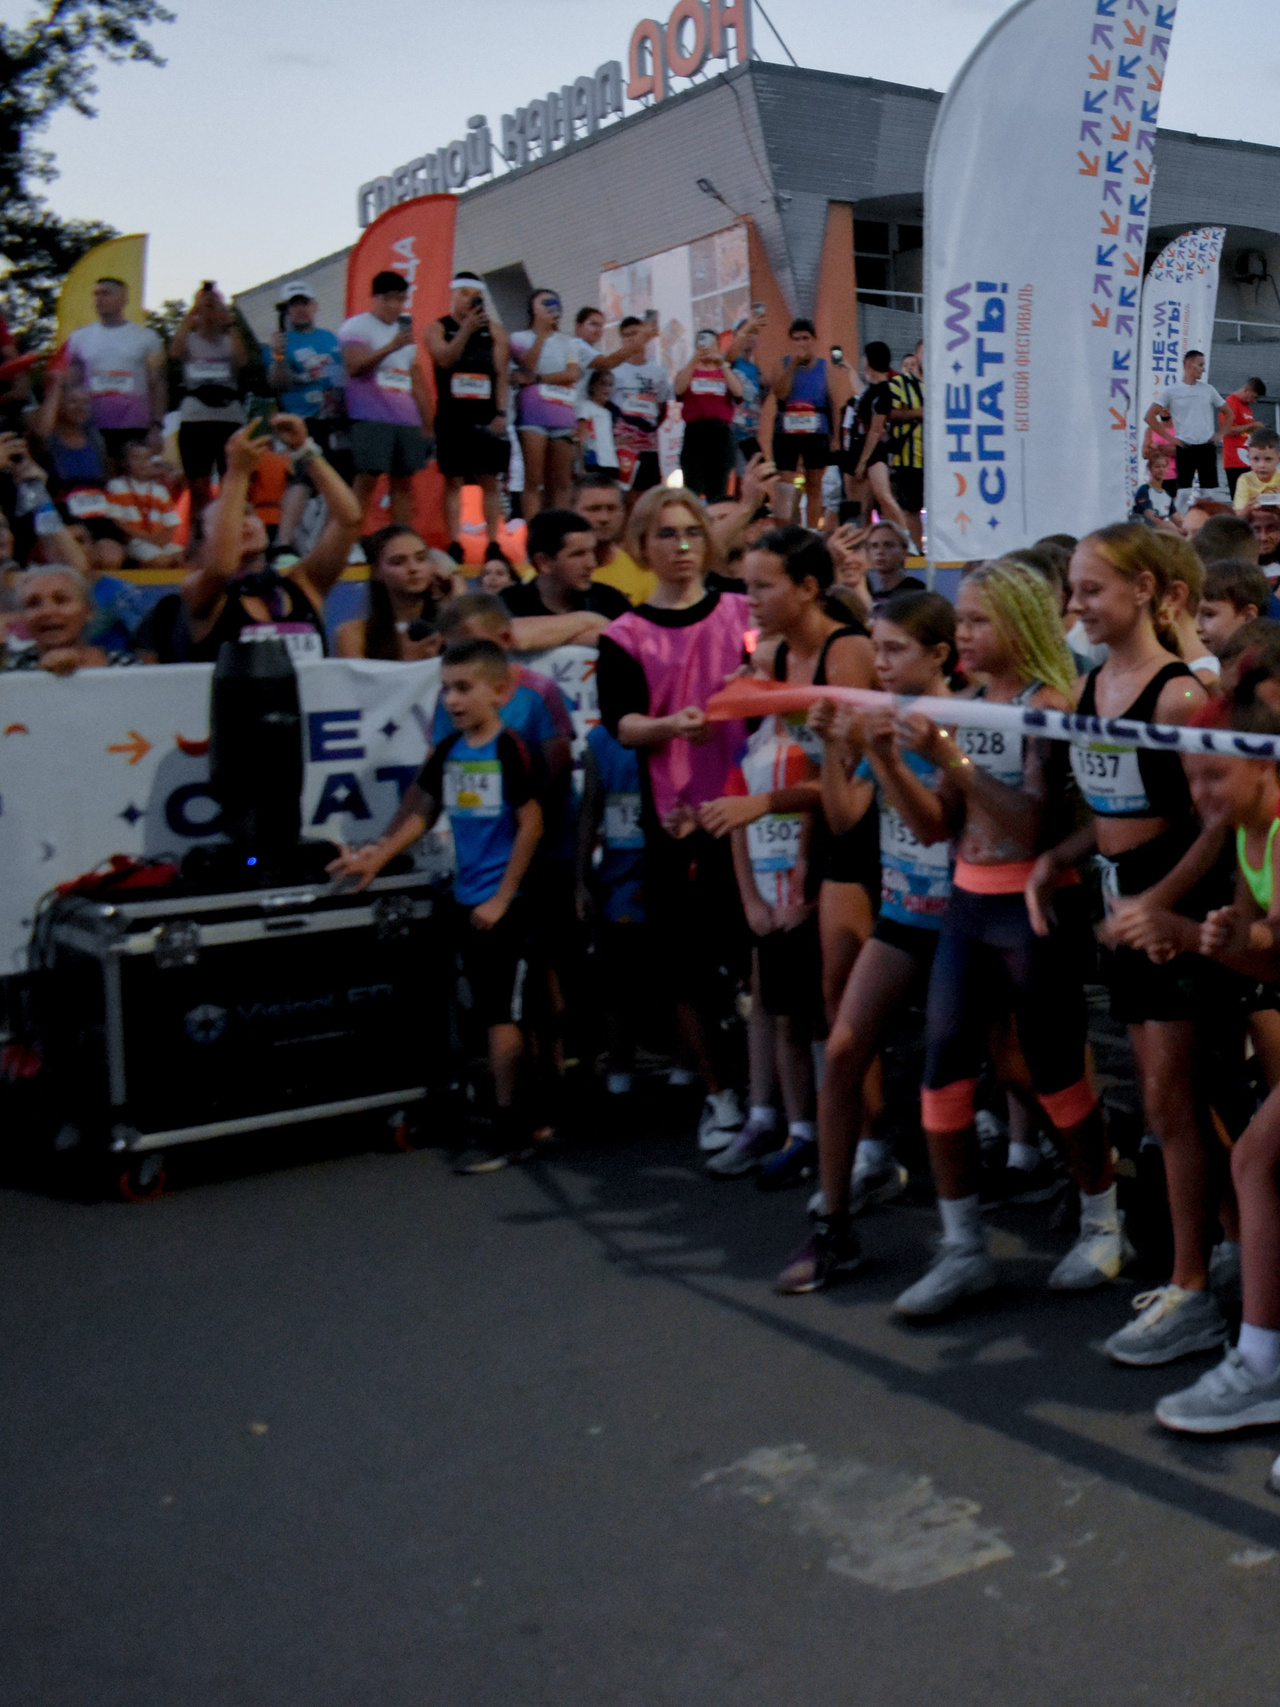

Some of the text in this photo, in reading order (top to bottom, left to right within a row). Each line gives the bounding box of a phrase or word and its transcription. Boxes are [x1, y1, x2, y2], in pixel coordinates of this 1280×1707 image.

[501, 60, 625, 162] КАНАЛ
[627, 0, 754, 102] ДОН
[976, 281, 1008, 504] СПАТЬ!
[1012, 284, 1034, 432] БЕГОВОЙ ФЕСТИВАЛЬ
[1152, 340, 1165, 372] НЕ
[946, 383, 972, 462] НЕ
[963, 732, 1005, 754] 528
[1078, 751, 1120, 778] 1537
